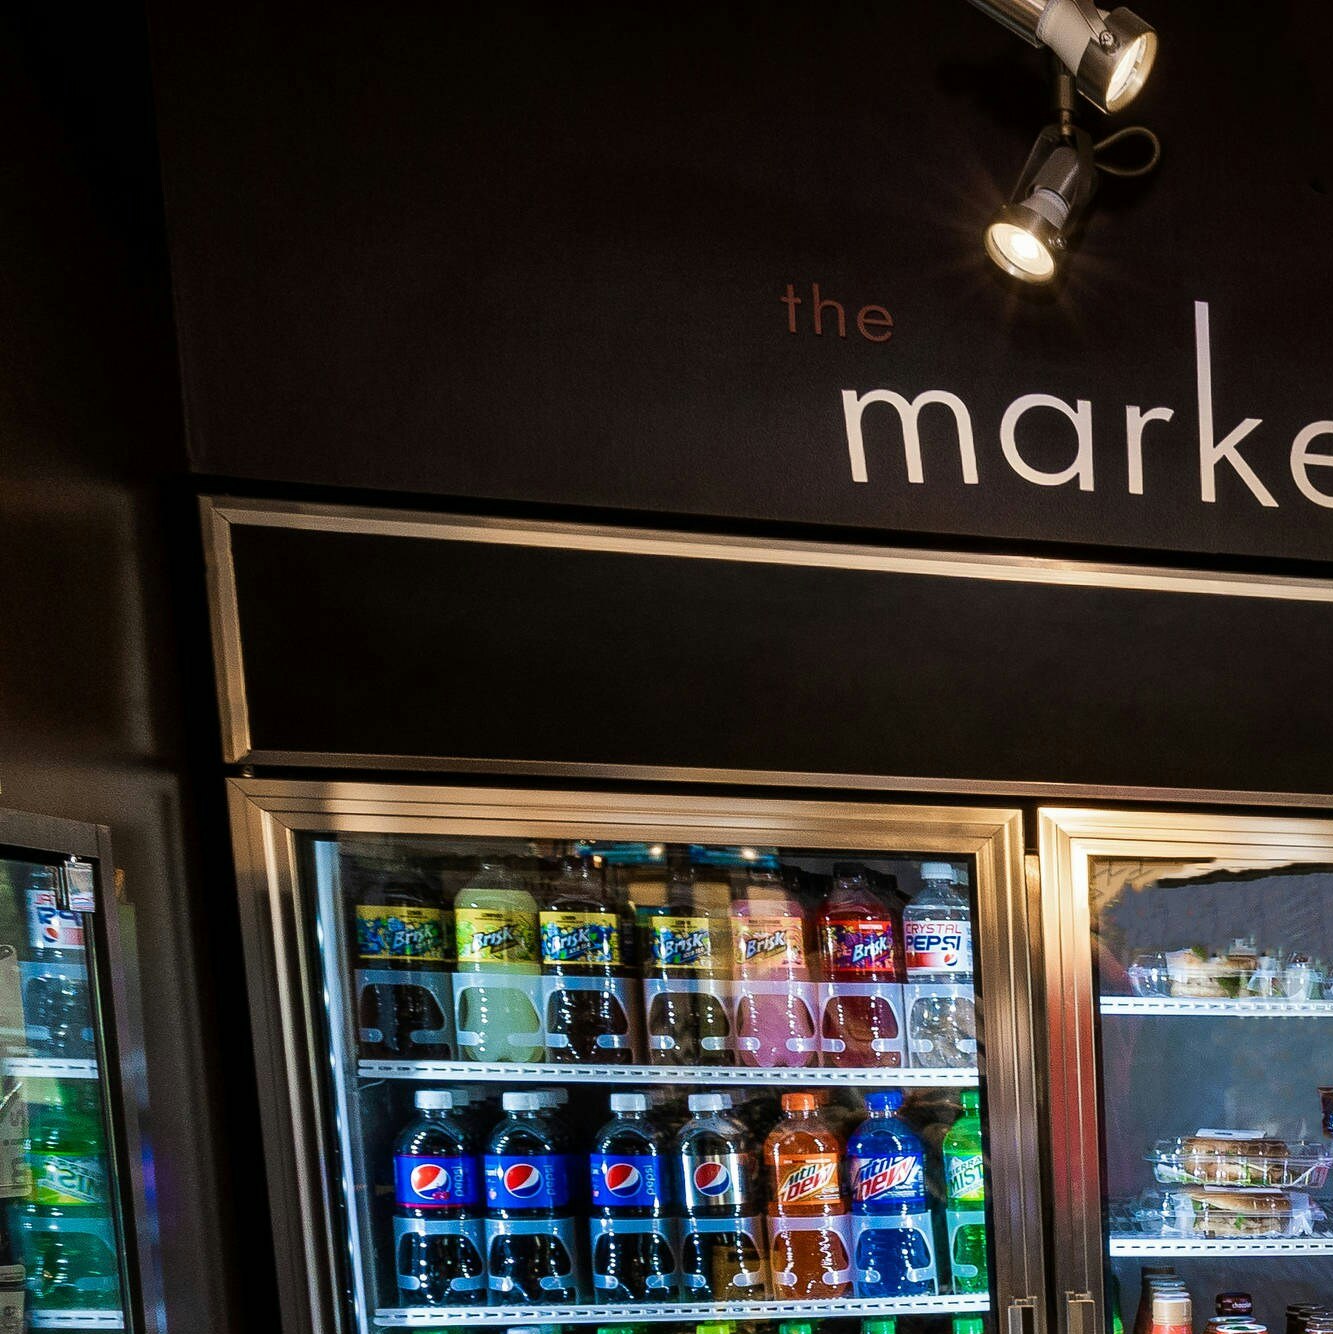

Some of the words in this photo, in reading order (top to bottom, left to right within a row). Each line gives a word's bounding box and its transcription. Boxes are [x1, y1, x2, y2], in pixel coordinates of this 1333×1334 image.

[780, 283, 895, 343] the
[906, 923, 962, 935] CRYSTAL
[906, 936, 962, 951] PEPSI
